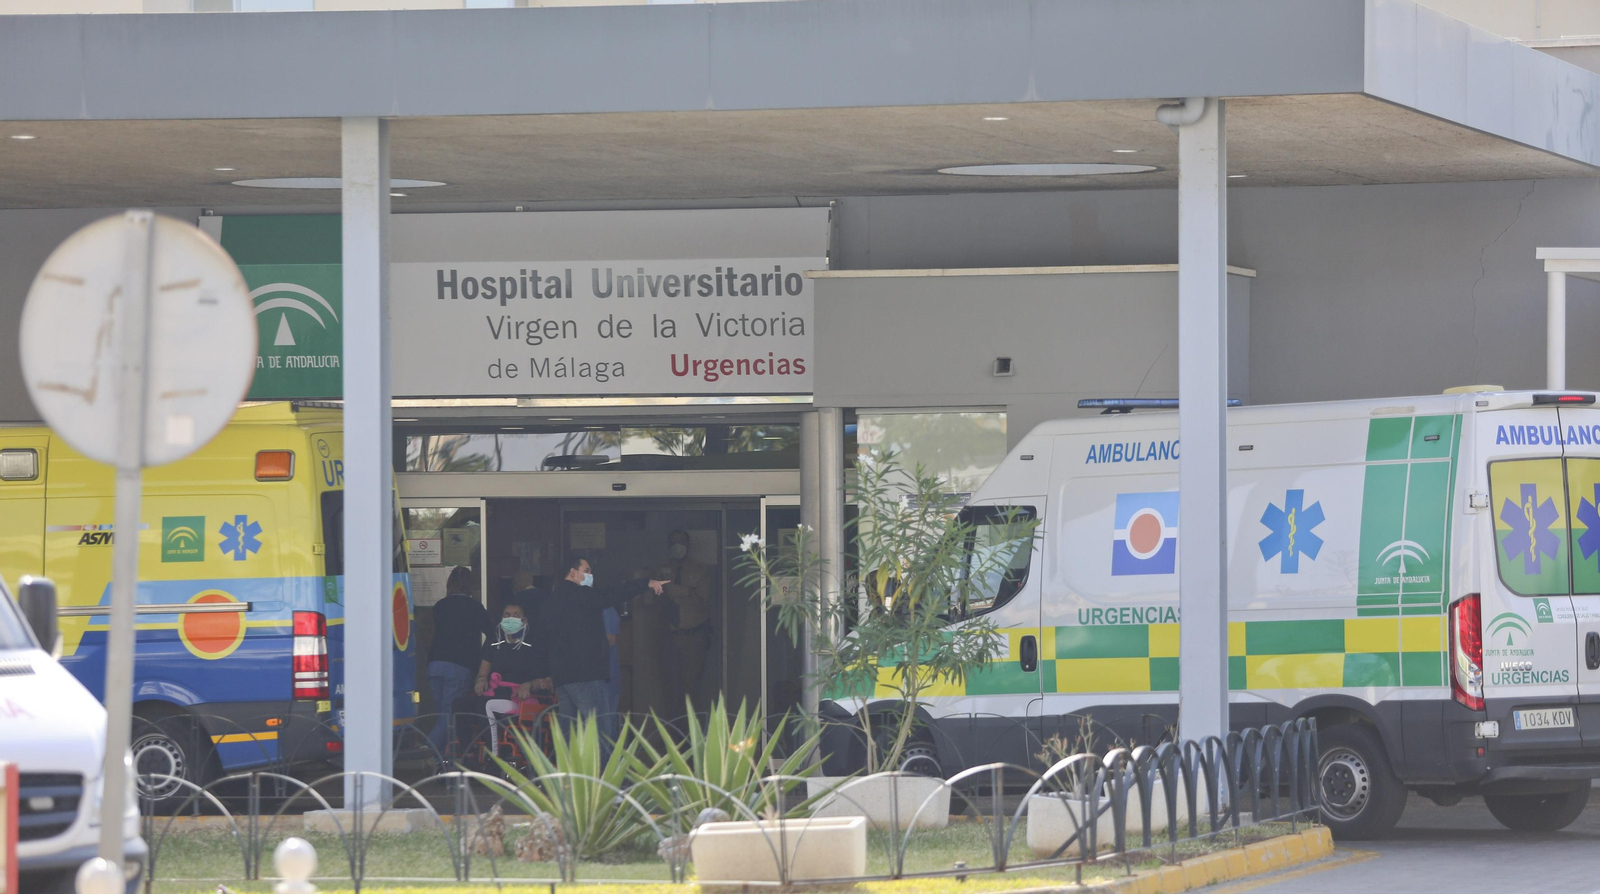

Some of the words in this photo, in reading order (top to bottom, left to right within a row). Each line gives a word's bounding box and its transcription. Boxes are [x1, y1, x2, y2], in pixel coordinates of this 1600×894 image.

[437, 269, 572, 306] Hospital
[592, 265, 803, 298] Universitario
[486, 315, 577, 345] Virgen
[598, 314, 632, 338] de
[653, 313, 676, 338] la
[696, 312, 805, 337] Victoria
[268, 356, 281, 368] DE
[286, 355, 340, 368] ANDALUCIA
[488, 358, 518, 378] de
[530, 357, 624, 382] Málaga
[671, 352, 806, 382] Urgencias
[1495, 424, 1600, 445] AMBULANC
[1085, 440, 1180, 464] AMBULANC
[1374, 577, 1391, 585] JUNTA
[1393, 576, 1400, 584] DE
[1401, 575, 1431, 584] ANDALUCIA
[1485, 649, 1500, 657] JUNTA
[1500, 661, 1532, 672] IVECO
[1491, 670, 1569, 686] URGENCIAS
[1523, 712, 1550, 727] 1034
[1552, 711, 1571, 725] KDV
